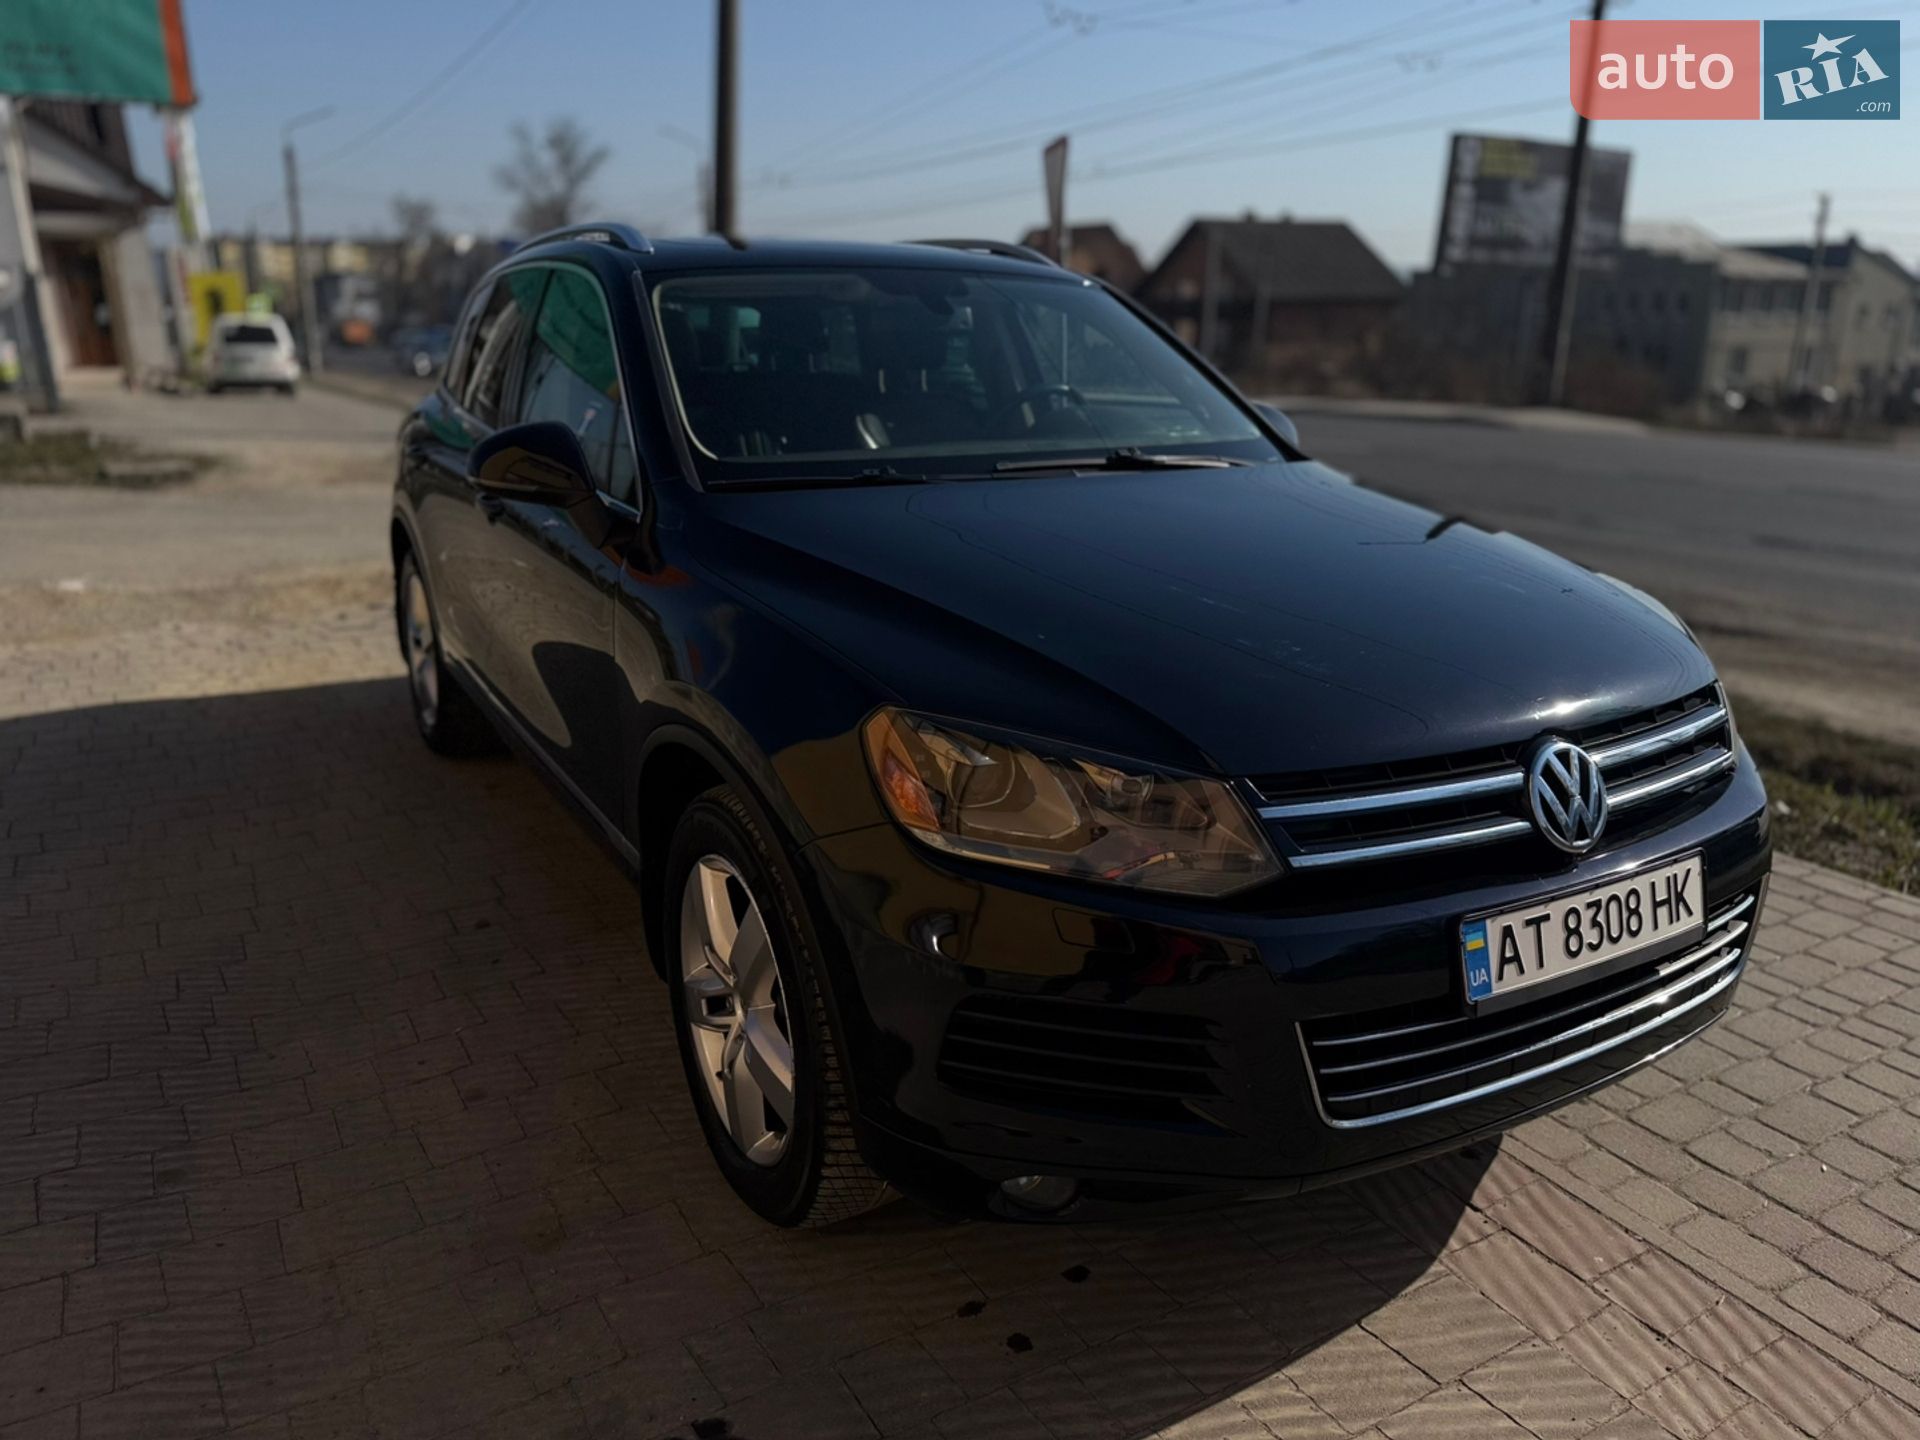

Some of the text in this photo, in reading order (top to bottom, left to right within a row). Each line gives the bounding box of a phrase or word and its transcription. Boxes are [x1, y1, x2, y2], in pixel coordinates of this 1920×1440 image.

[1497, 867, 1694, 982] AT 8308 HK
[1469, 971, 1489, 987] UA
